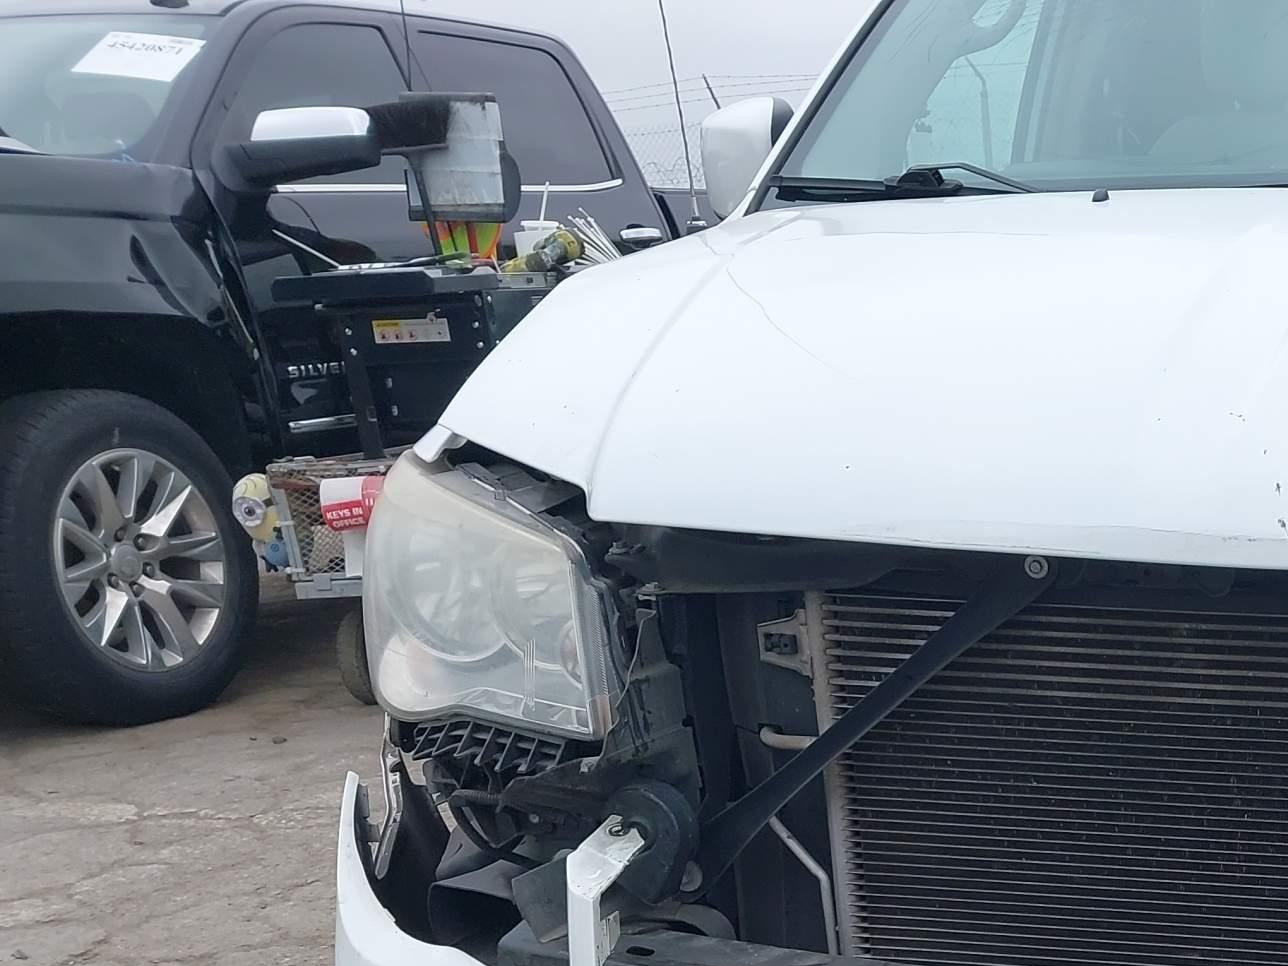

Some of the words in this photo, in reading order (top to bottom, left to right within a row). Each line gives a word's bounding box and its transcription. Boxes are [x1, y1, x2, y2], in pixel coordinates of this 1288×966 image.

[287, 361, 346, 378] SILVE
[326, 508, 351, 519] KEYS
[352, 506, 363, 516] IN
[332, 517, 367, 528] OFFICE
